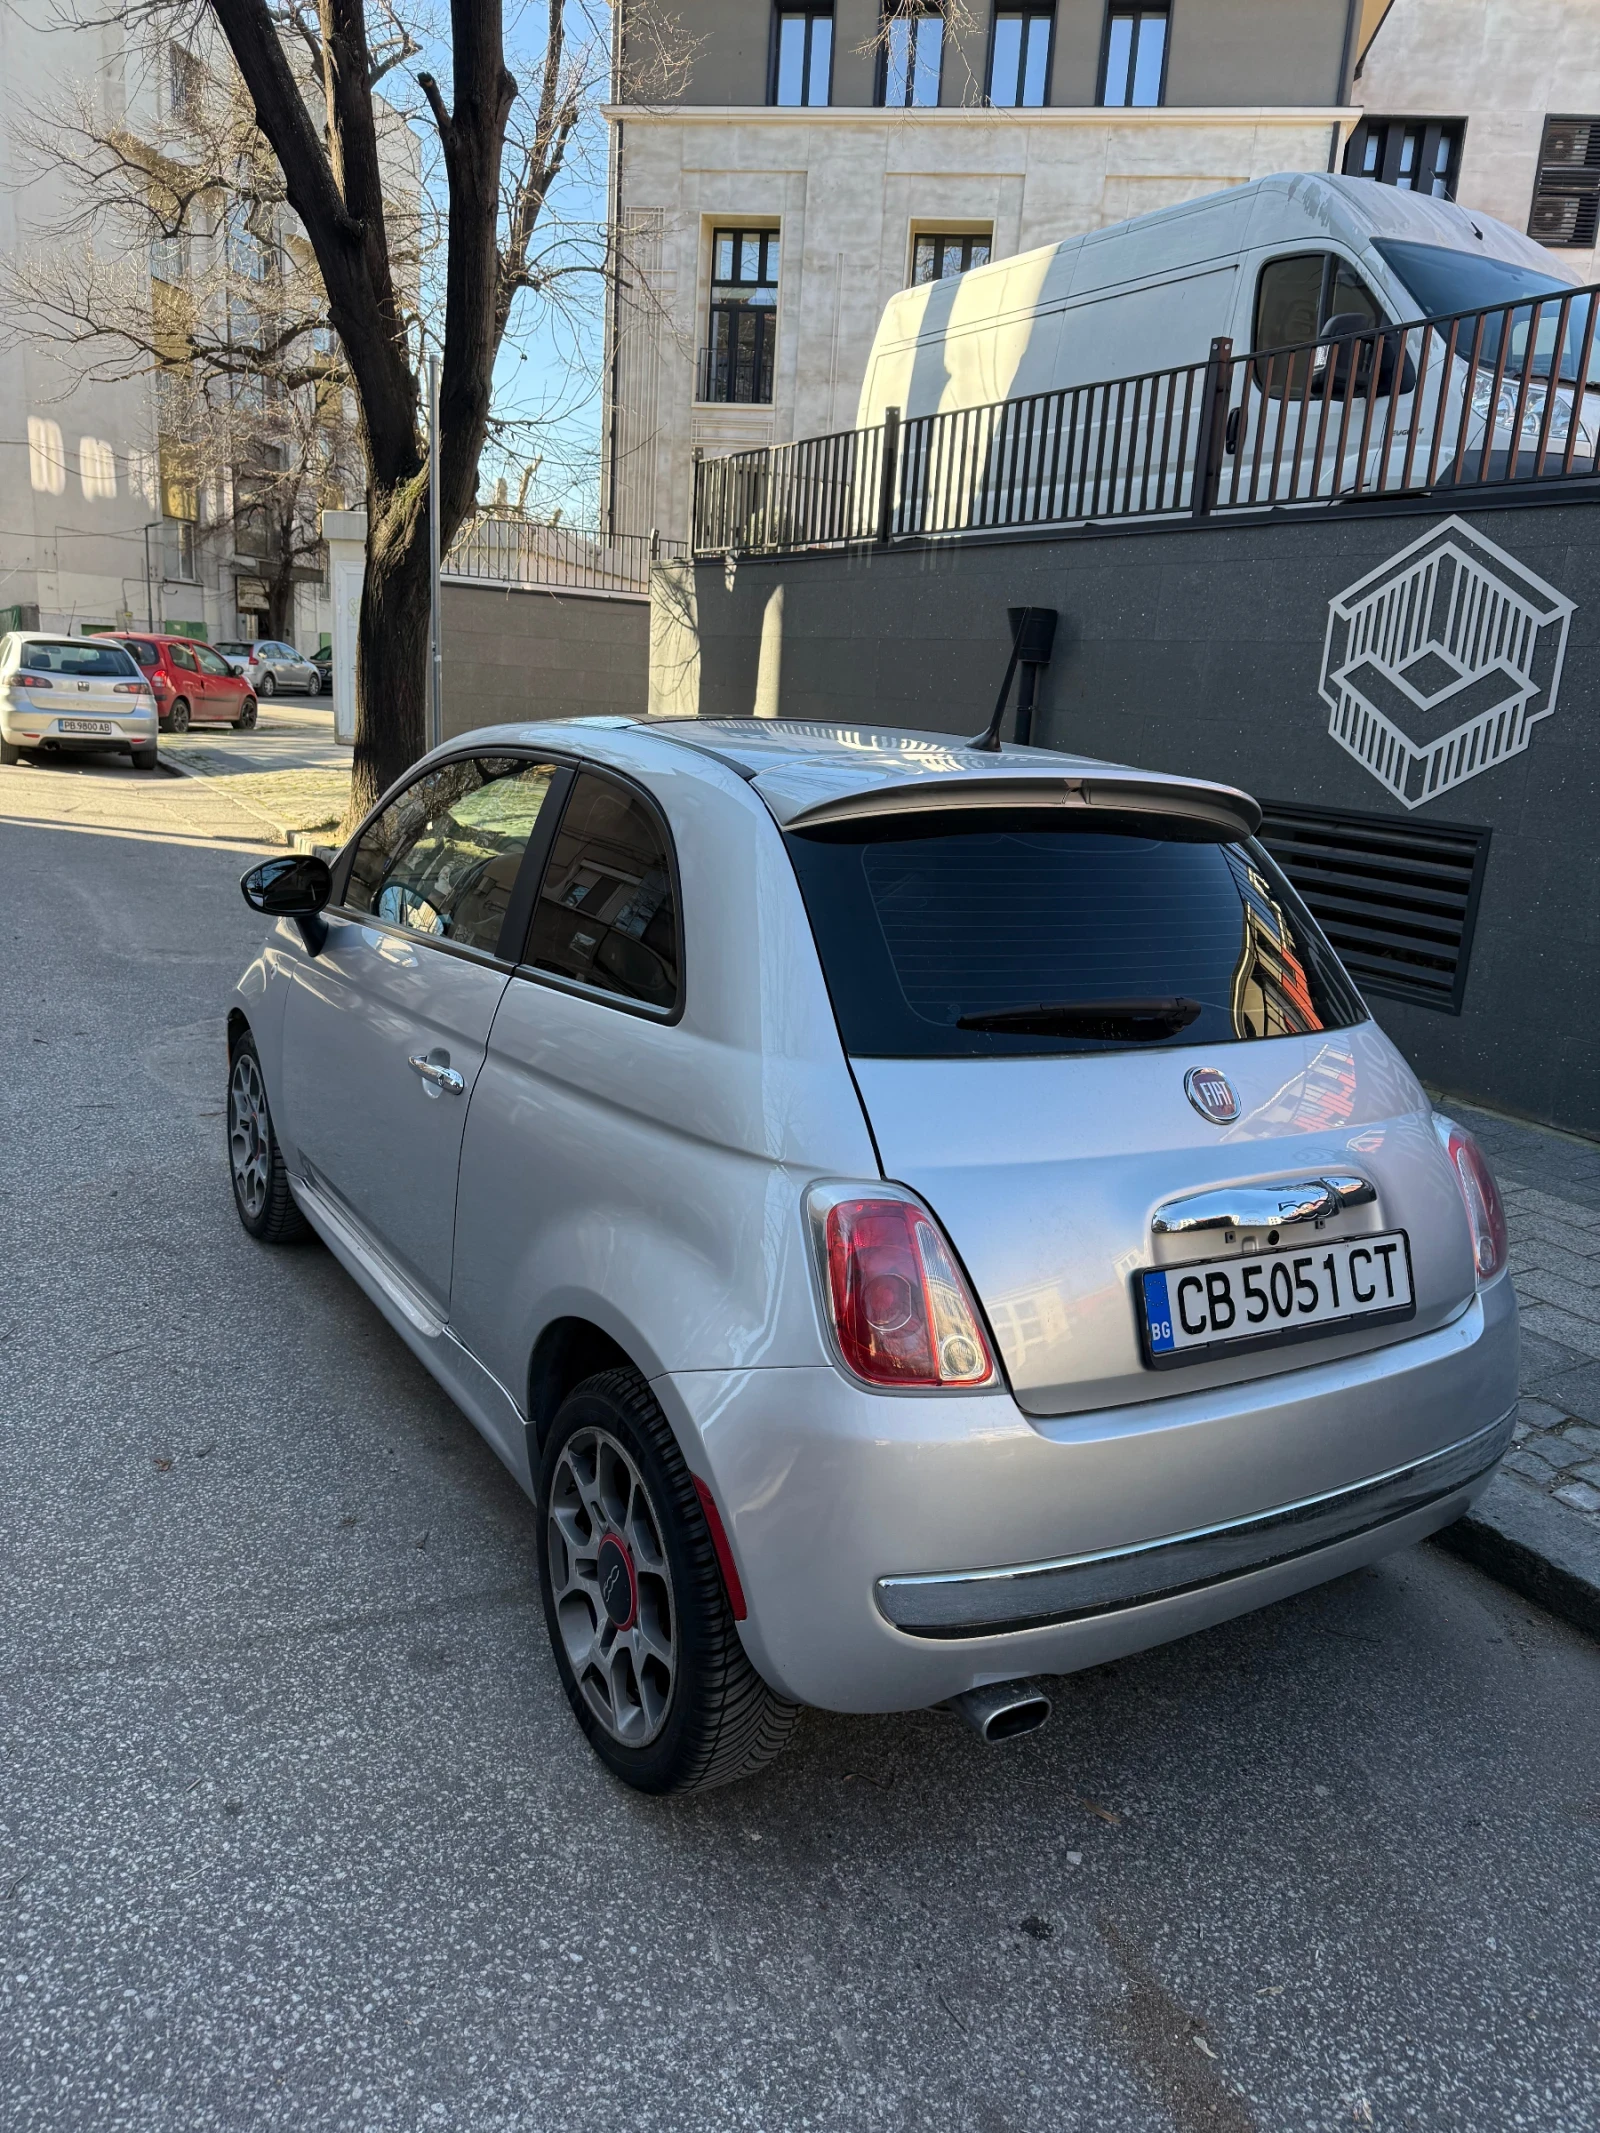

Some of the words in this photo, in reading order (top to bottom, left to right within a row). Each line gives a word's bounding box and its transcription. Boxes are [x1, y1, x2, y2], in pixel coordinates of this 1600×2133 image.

[1199, 1081, 1233, 1107] FIAT
[1277, 1199, 1333, 1223] 500
[1177, 1271, 1236, 1335] CB
[1241, 1253, 1340, 1323] 5051
[1349, 1243, 1398, 1303] CT
[1151, 1320, 1171, 1341] BG
